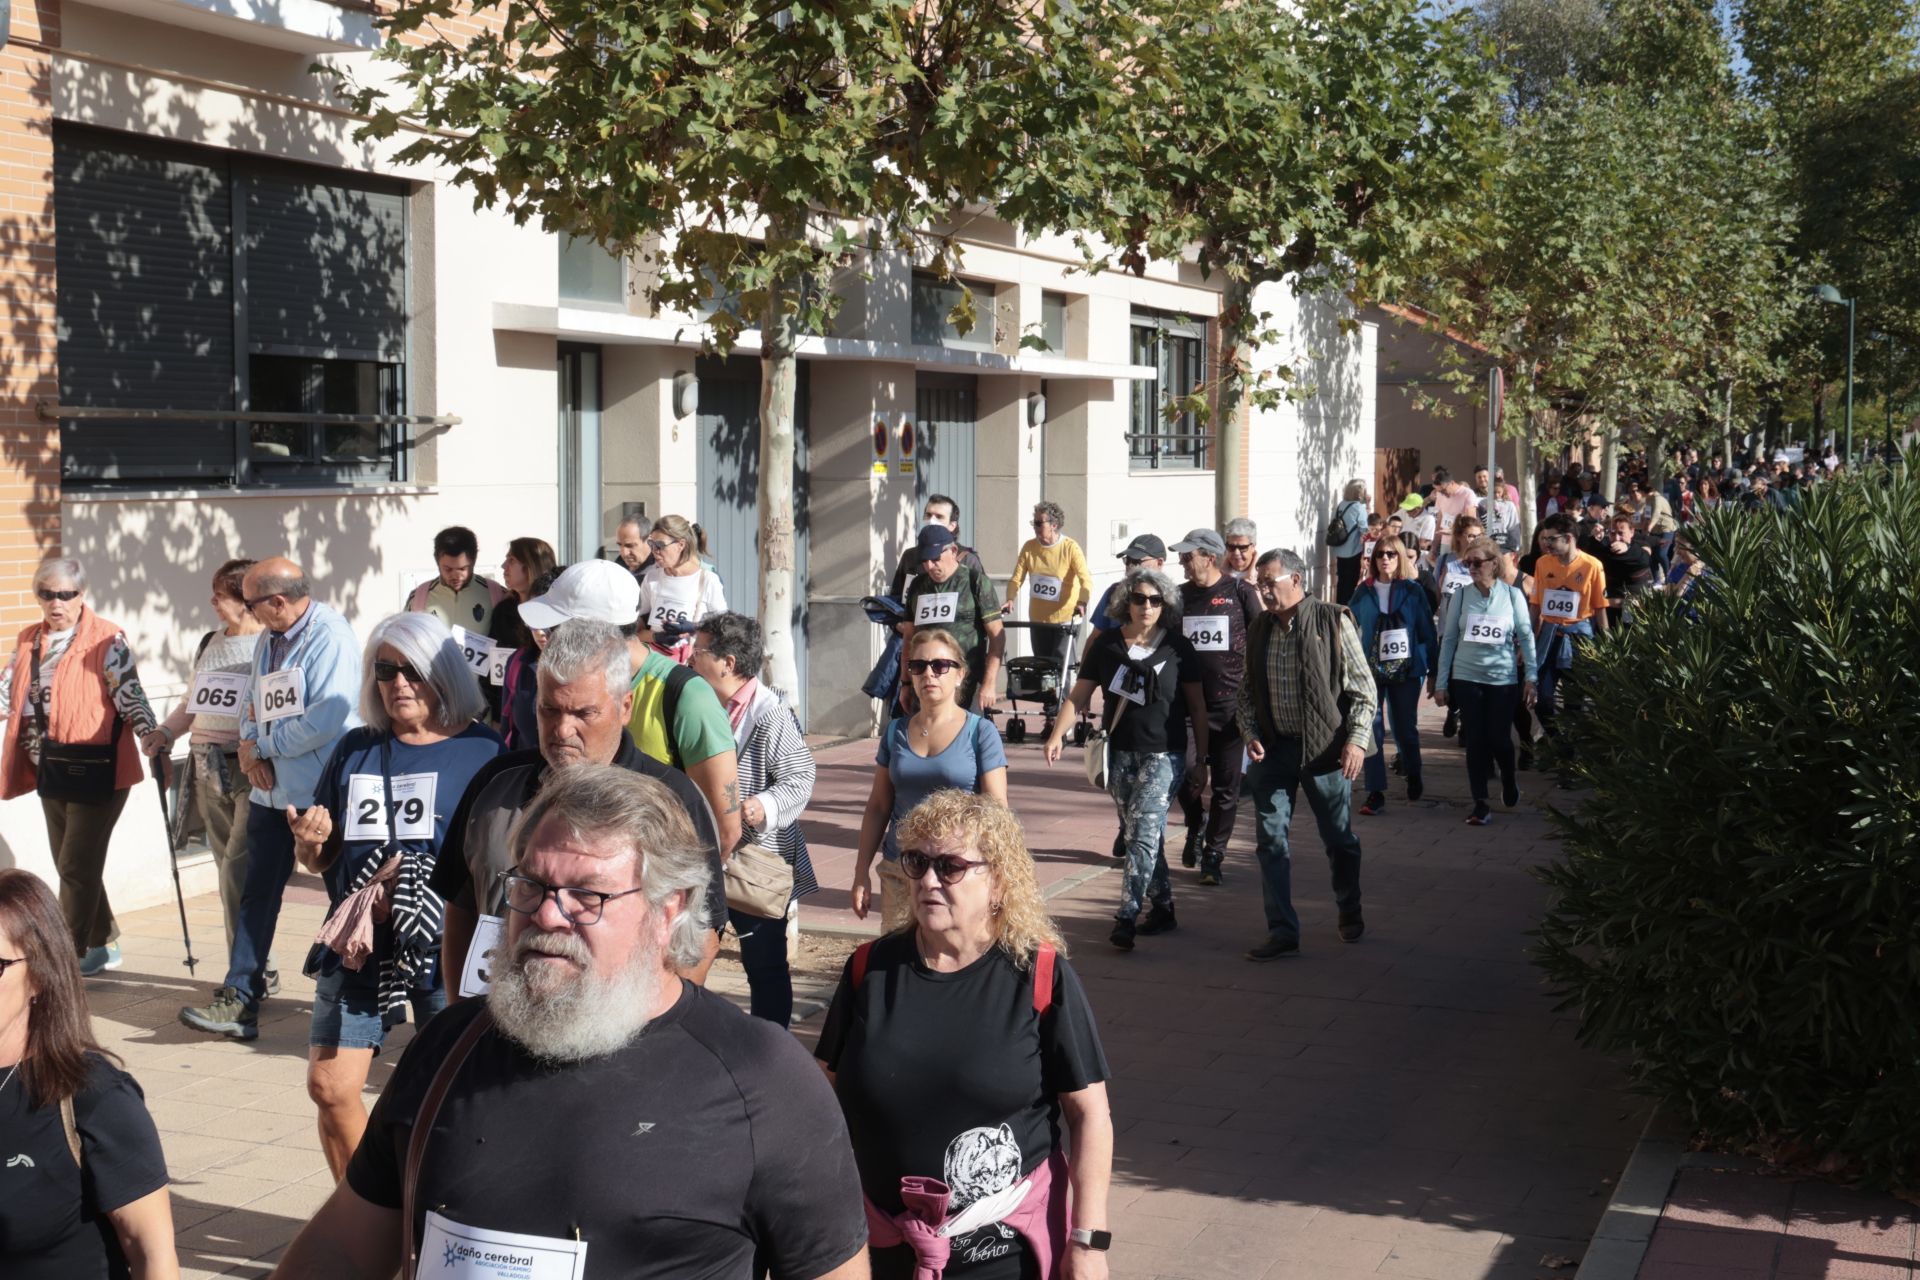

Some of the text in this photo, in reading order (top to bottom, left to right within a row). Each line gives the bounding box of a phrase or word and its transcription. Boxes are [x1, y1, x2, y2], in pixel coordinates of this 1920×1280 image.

[671, 424, 679, 443] 6
[1027, 433, 1034, 453] 4
[1033, 583, 1057, 596] 029
[655, 606, 688, 622] 266
[920, 605, 951, 620] 519
[1547, 600, 1574, 613] 049
[1189, 630, 1224, 645] 494
[1471, 625, 1502, 639] 536
[1381, 641, 1407, 655] 495
[196, 687, 238, 707] 065
[264, 686, 297, 711] 064
[457, 1245, 534, 1266] daño cerebral
